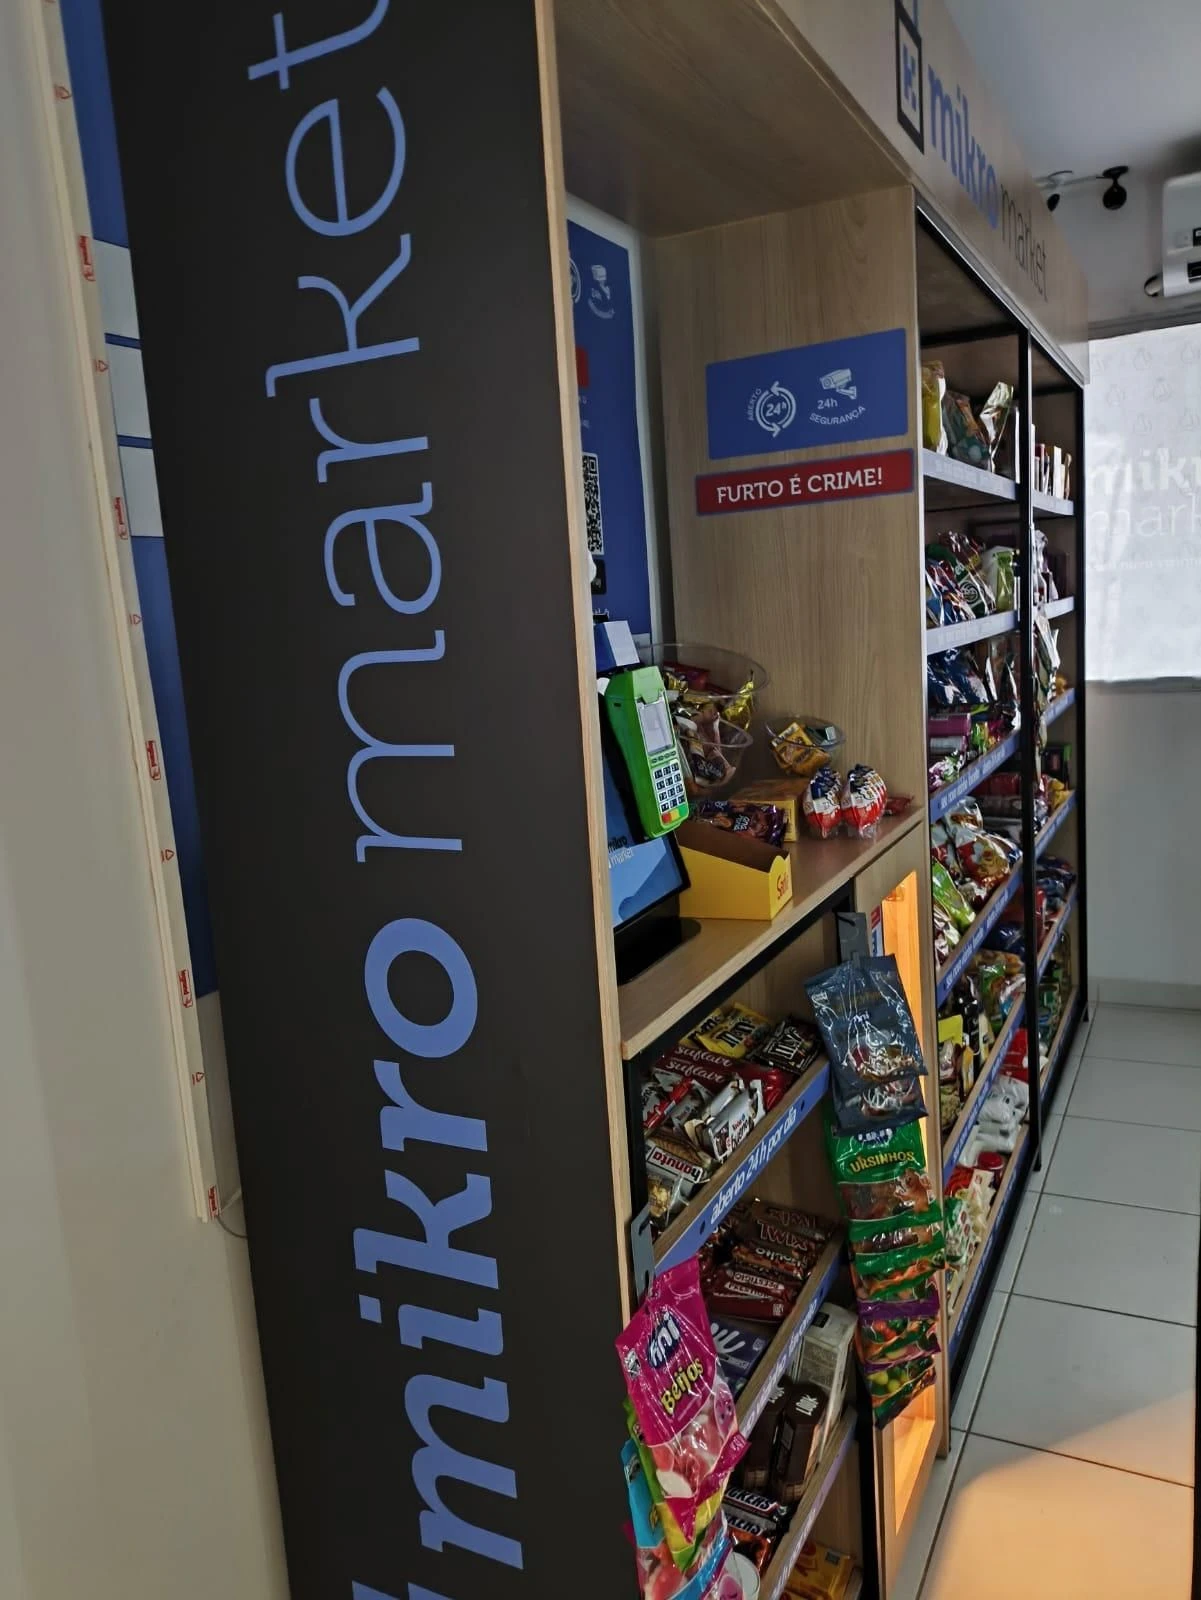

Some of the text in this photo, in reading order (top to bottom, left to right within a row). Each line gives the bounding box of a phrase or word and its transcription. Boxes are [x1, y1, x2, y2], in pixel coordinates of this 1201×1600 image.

[927, 63, 1048, 303] mikro market
[746, 387, 763, 421] ABERTO
[809, 405, 867, 426] SEGURANÇA
[816, 397, 838, 410] 24h
[716, 466, 883, 504] FURTO É CRIME!
[251, 0, 524, 1569] mikro market
[652, 1152, 701, 1182] hanuta
[710, 1173, 745, 1226] aberto
[766, 1123, 786, 1158] por
[783, 1105, 798, 1134] dia
[849, 1150, 915, 1173] URSINHOS
[660, 1356, 704, 1416] Beijos
